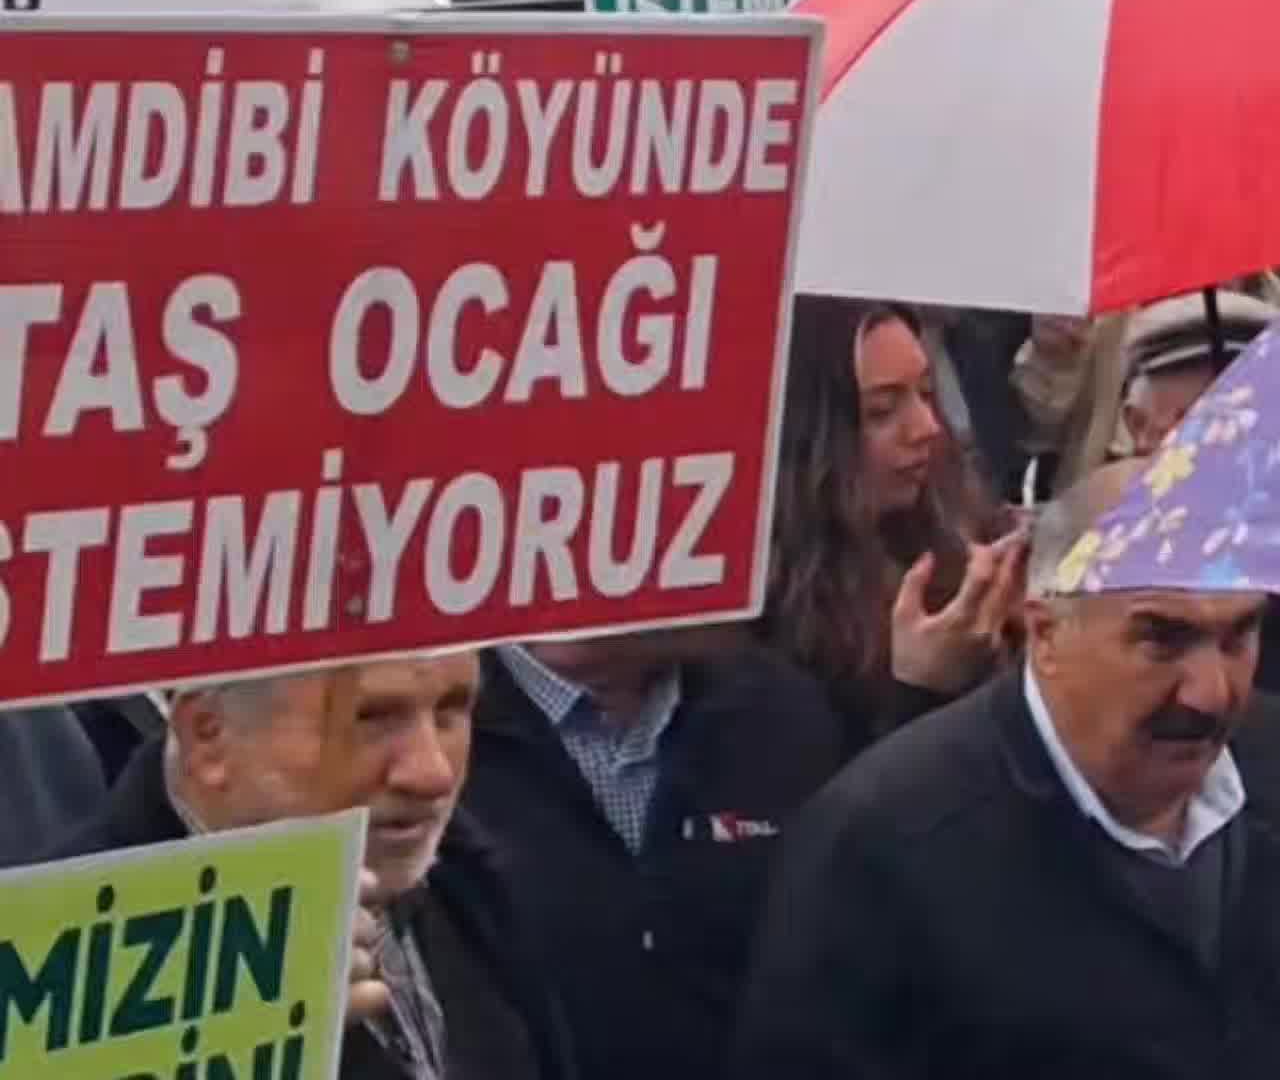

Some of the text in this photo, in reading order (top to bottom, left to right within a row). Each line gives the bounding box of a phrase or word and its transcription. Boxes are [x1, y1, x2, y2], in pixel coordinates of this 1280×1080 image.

[378, 51, 796, 203] KÖYÜNDE
[0, 221, 719, 470] TAŞ OCAĞI
